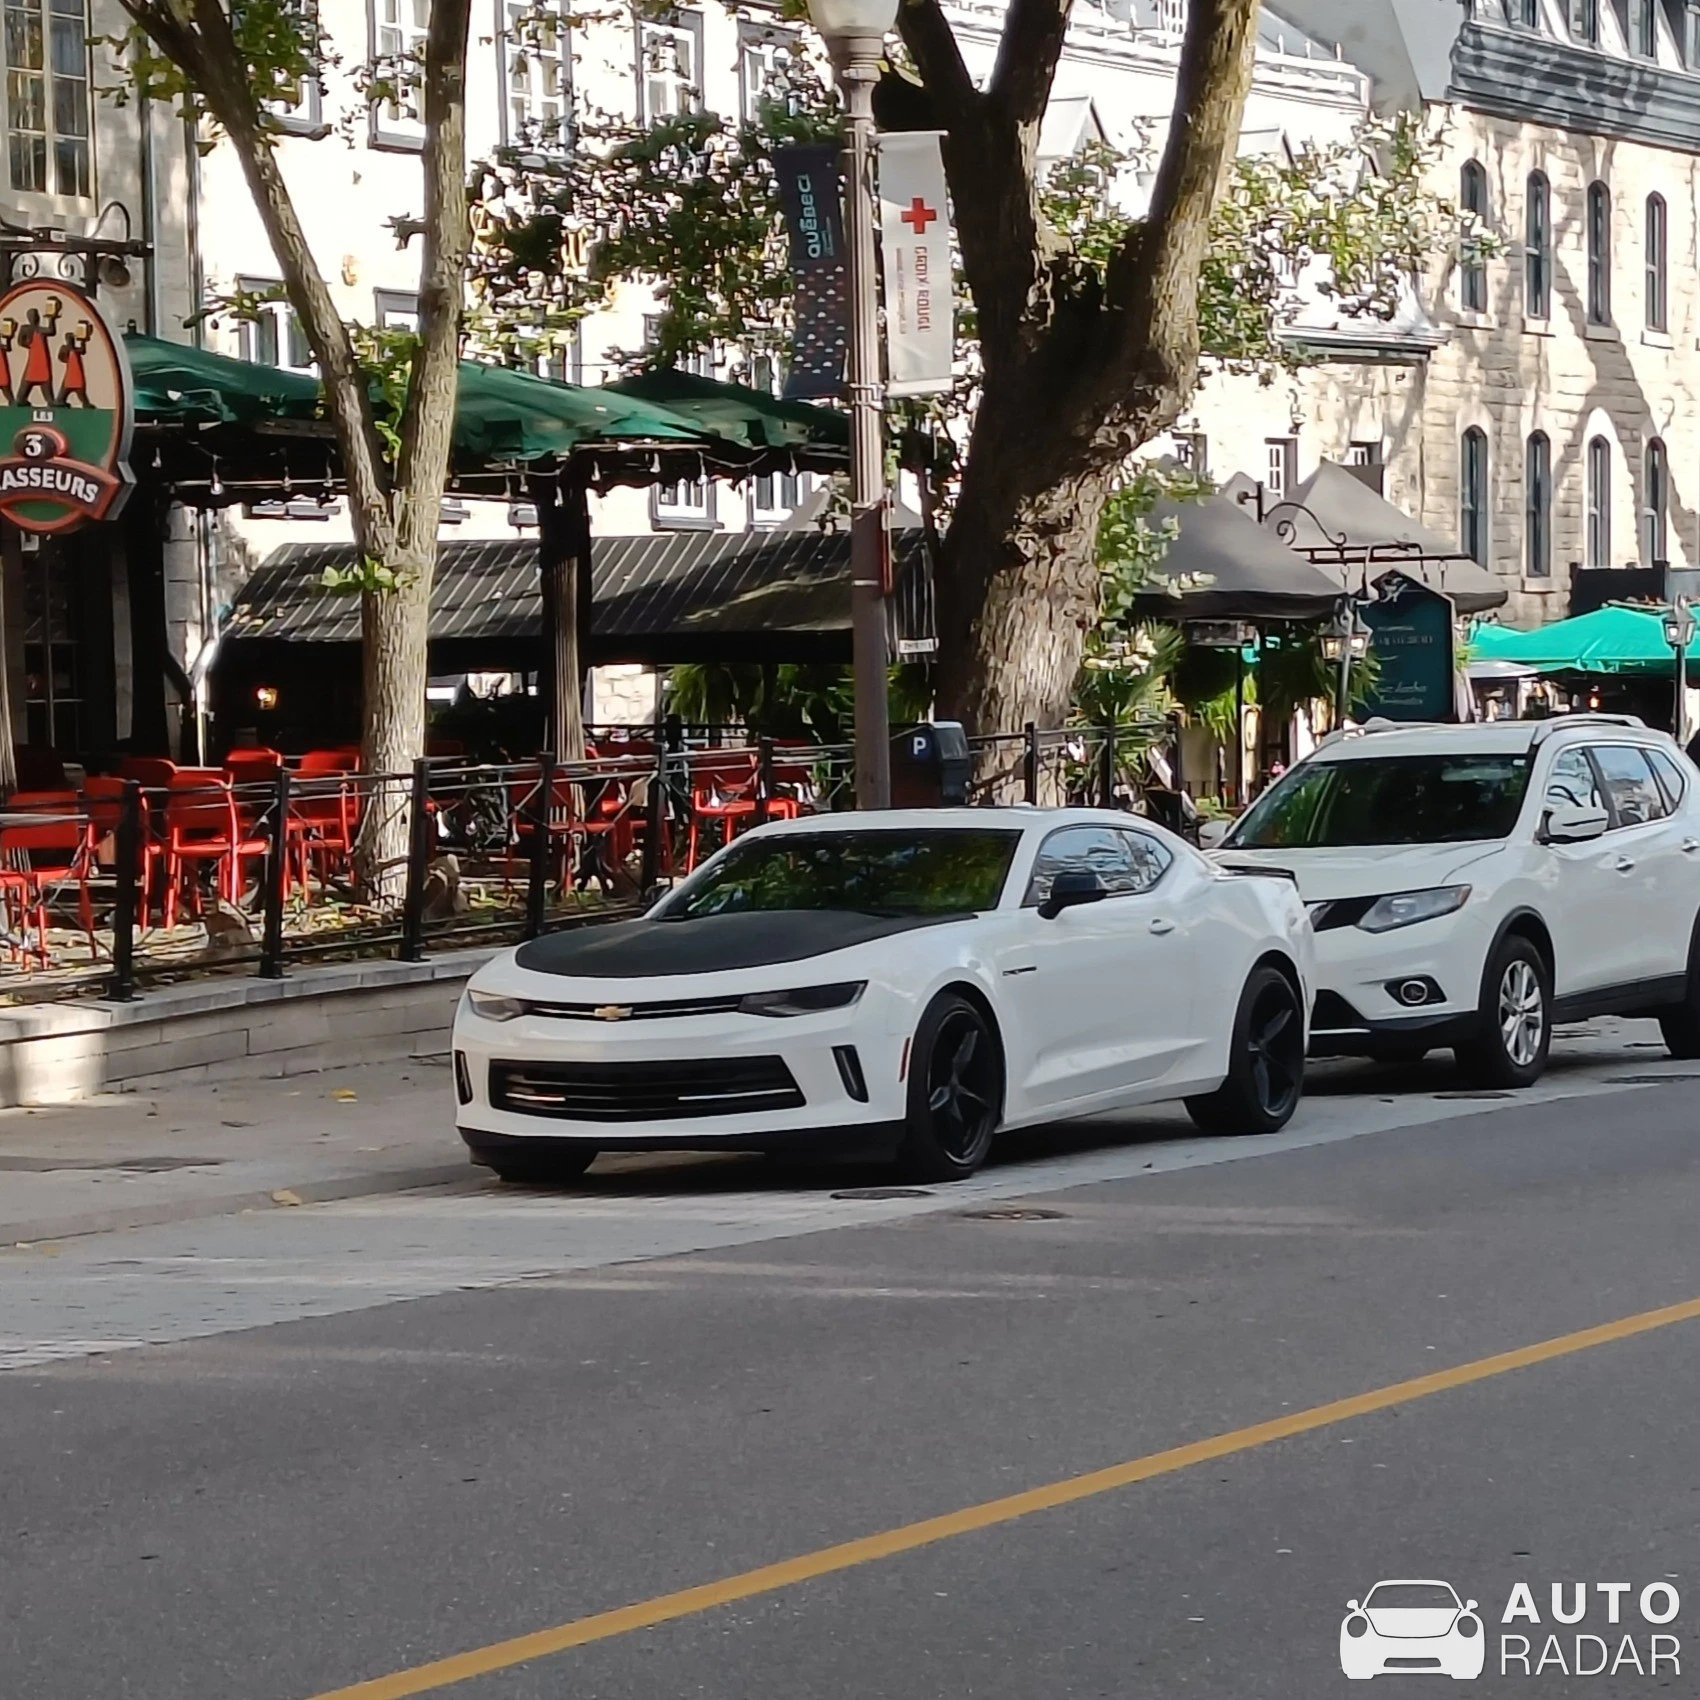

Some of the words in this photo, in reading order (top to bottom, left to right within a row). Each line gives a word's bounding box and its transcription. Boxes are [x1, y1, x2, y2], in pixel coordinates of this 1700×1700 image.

[25, 434, 42, 457] 3
[0, 467, 99, 503] ASSEURS
[913, 736, 926, 755] P
